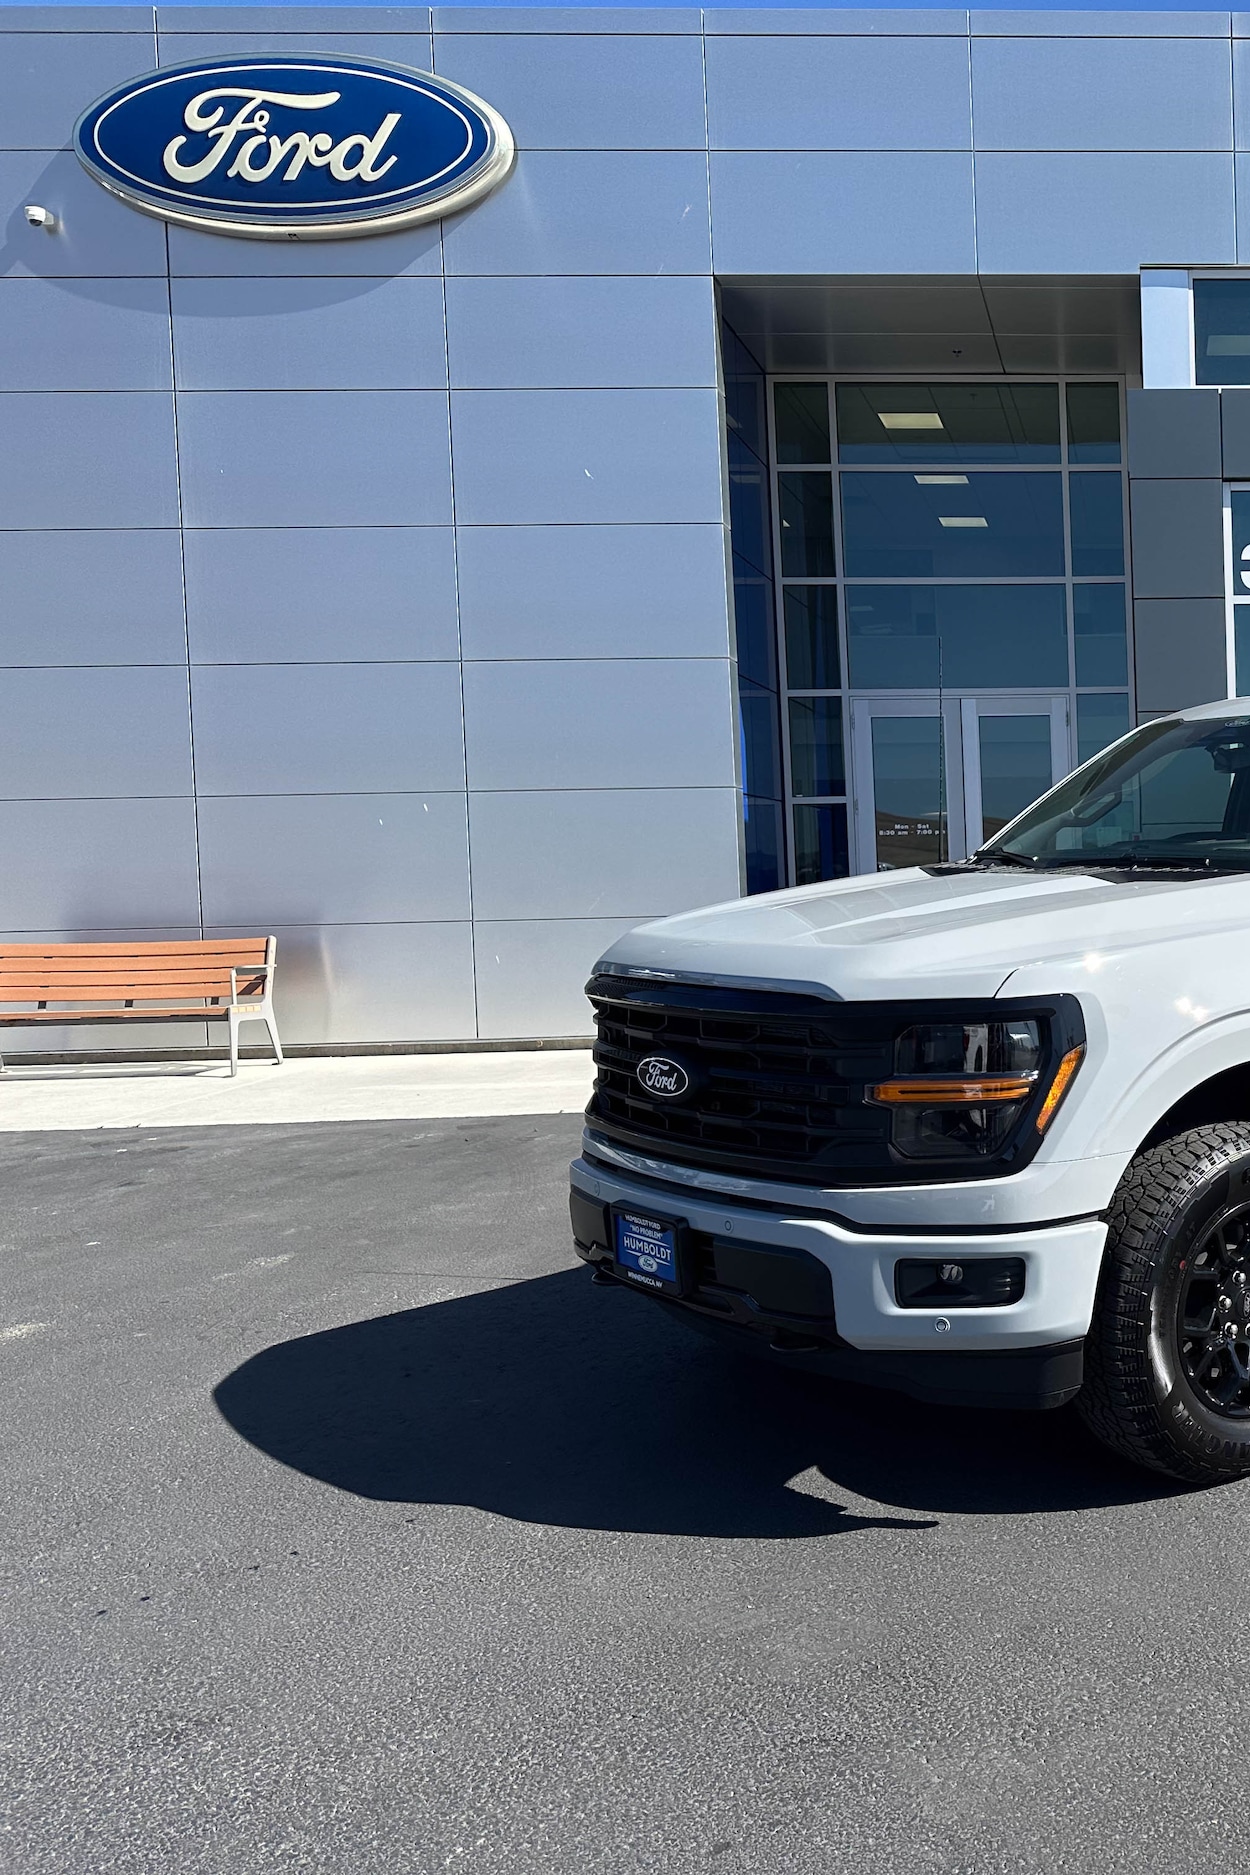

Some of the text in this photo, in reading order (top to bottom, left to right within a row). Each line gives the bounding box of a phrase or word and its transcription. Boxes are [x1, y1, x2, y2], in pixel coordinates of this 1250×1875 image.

[162, 87, 402, 184] Ford
[646, 1061, 677, 1091] Ford
[623, 1236, 671, 1261] HUMBOLDT
